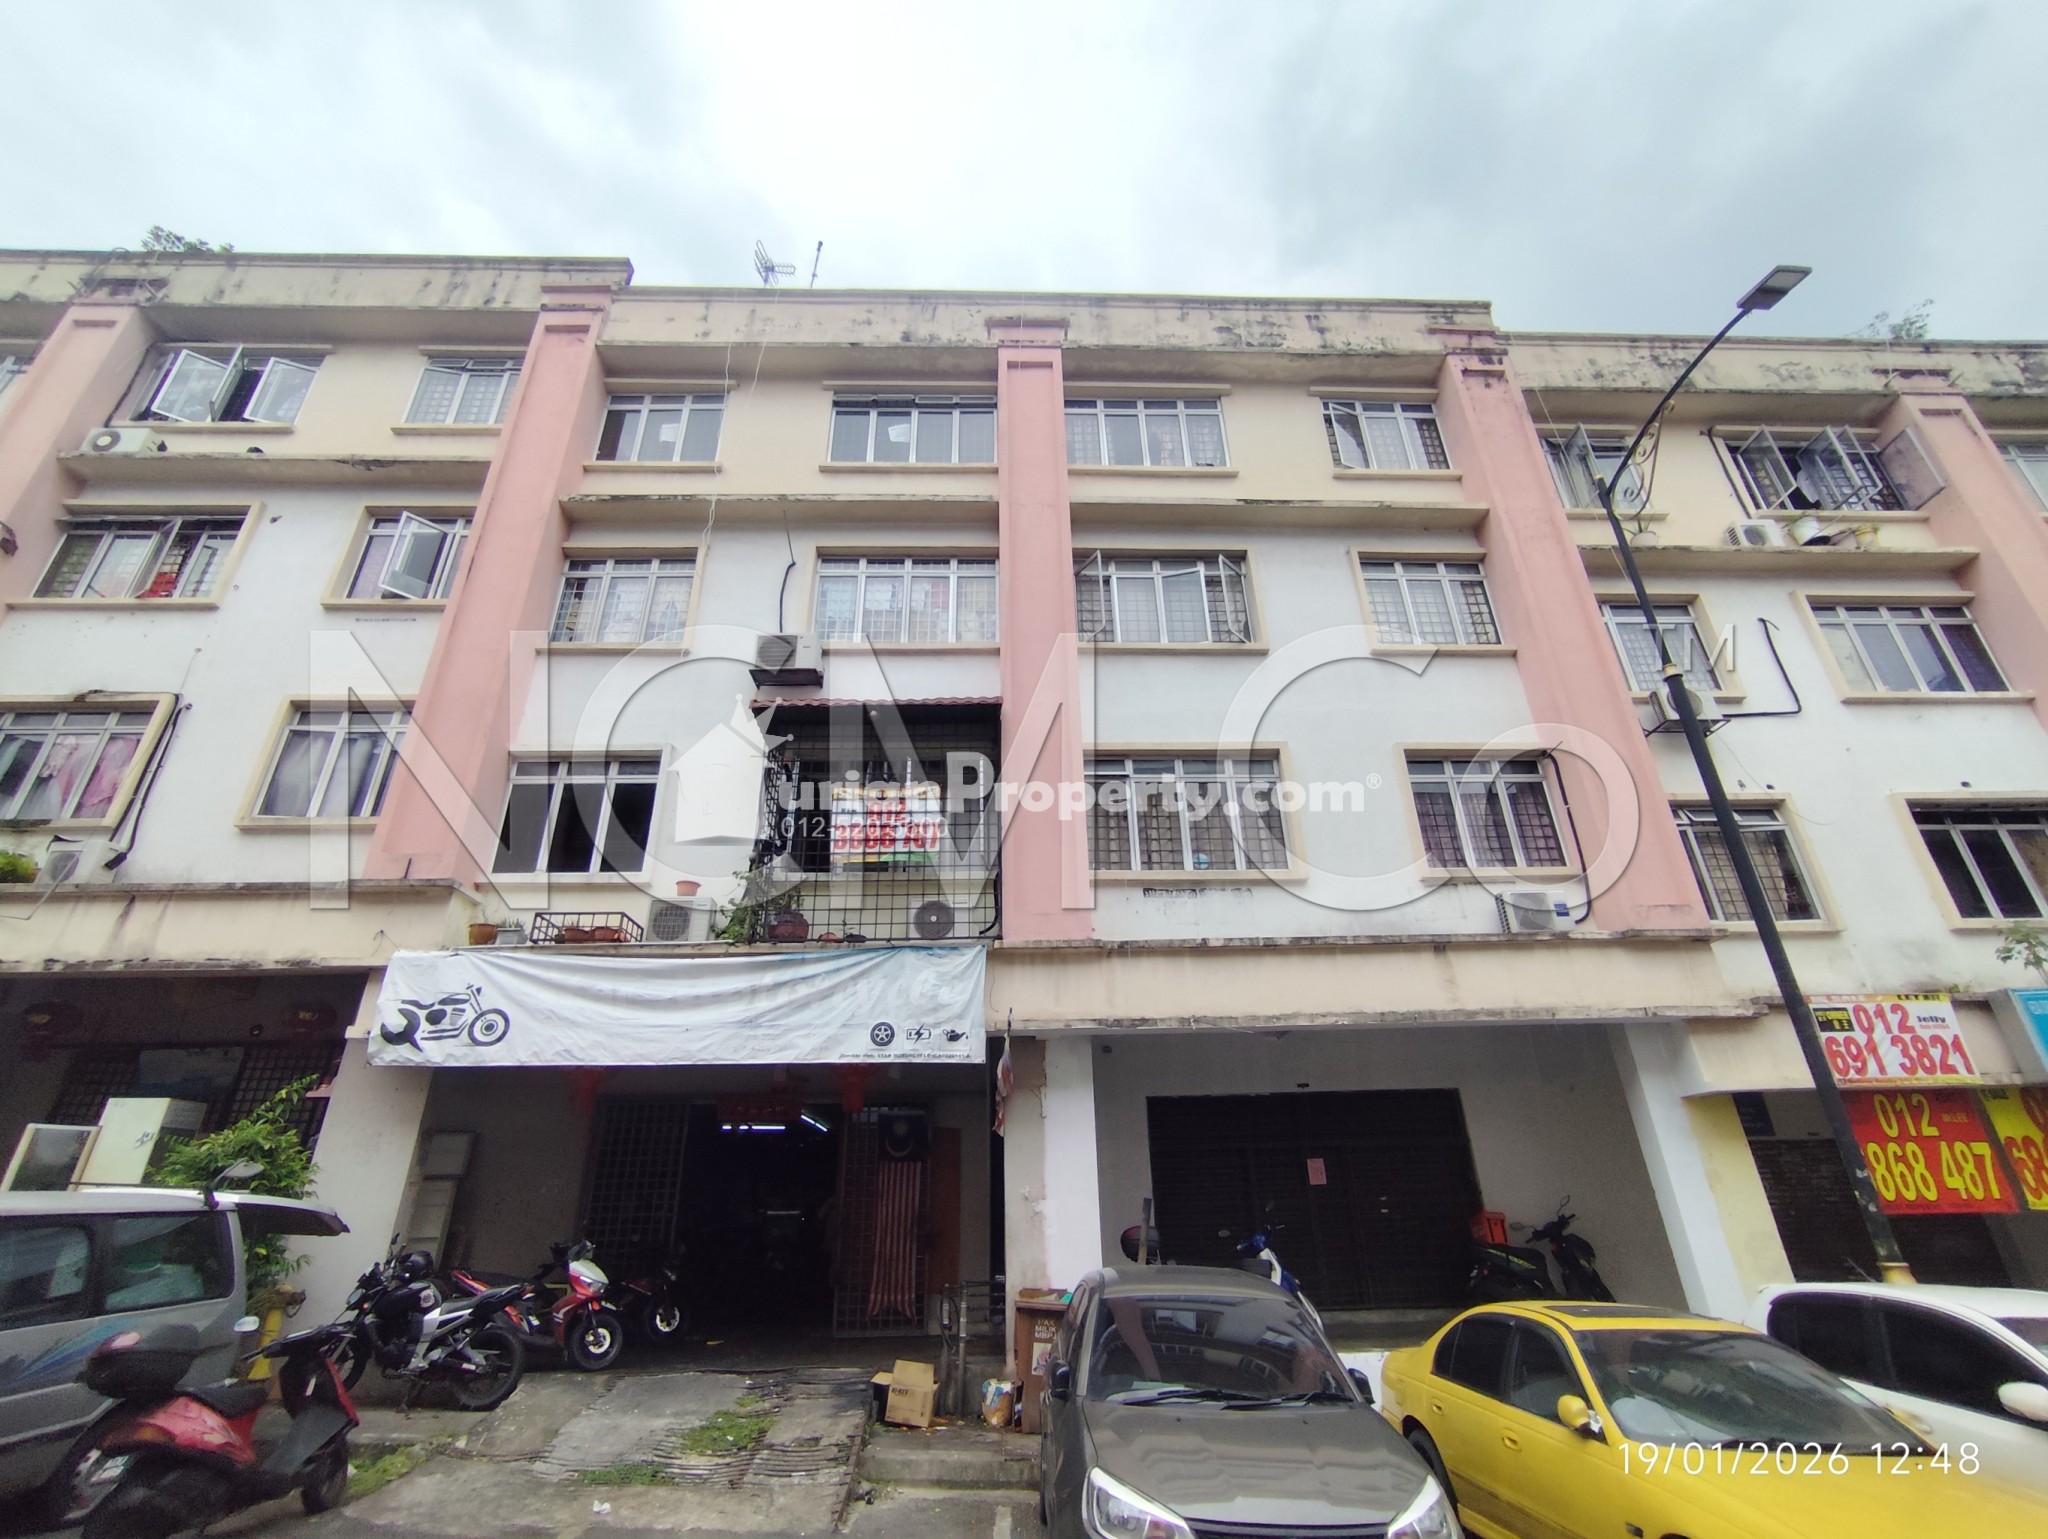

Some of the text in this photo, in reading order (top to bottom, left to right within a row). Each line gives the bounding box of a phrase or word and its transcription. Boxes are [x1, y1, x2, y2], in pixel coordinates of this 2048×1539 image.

[1853, 1003, 1917, 1035] 012
[1825, 1034, 1976, 1077] 691 3821
[1873, 1092, 1940, 1138] 012
[1866, 1140, 2001, 1202] 868 487
[2003, 1135, 2048, 1201] 68
